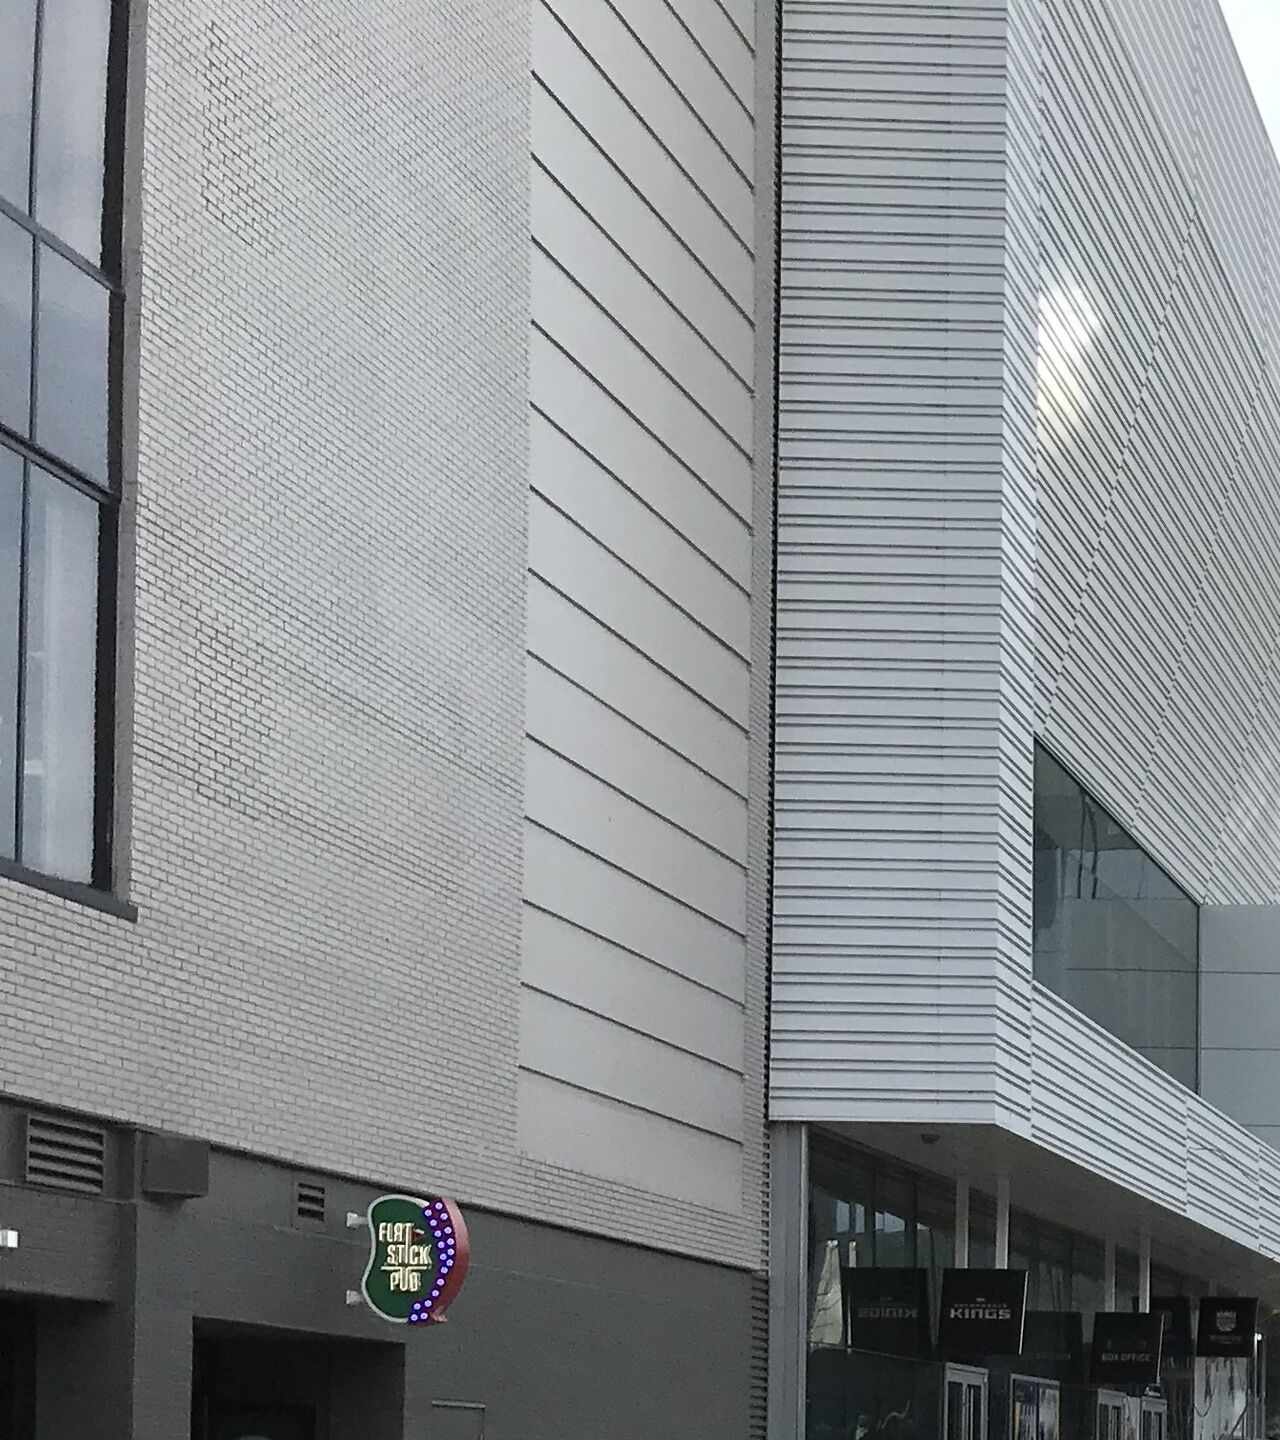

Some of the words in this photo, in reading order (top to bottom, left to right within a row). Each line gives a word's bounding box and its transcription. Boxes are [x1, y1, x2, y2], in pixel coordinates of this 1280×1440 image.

[378, 1222, 414, 1242] FLAT
[386, 1244, 431, 1265] STICK
[389, 1267, 421, 1292] PUB
[950, 1308, 1011, 1320] KINGS
[1102, 1353, 1119, 1362] BOX
[1121, 1353, 1151, 1363] OFFICE
